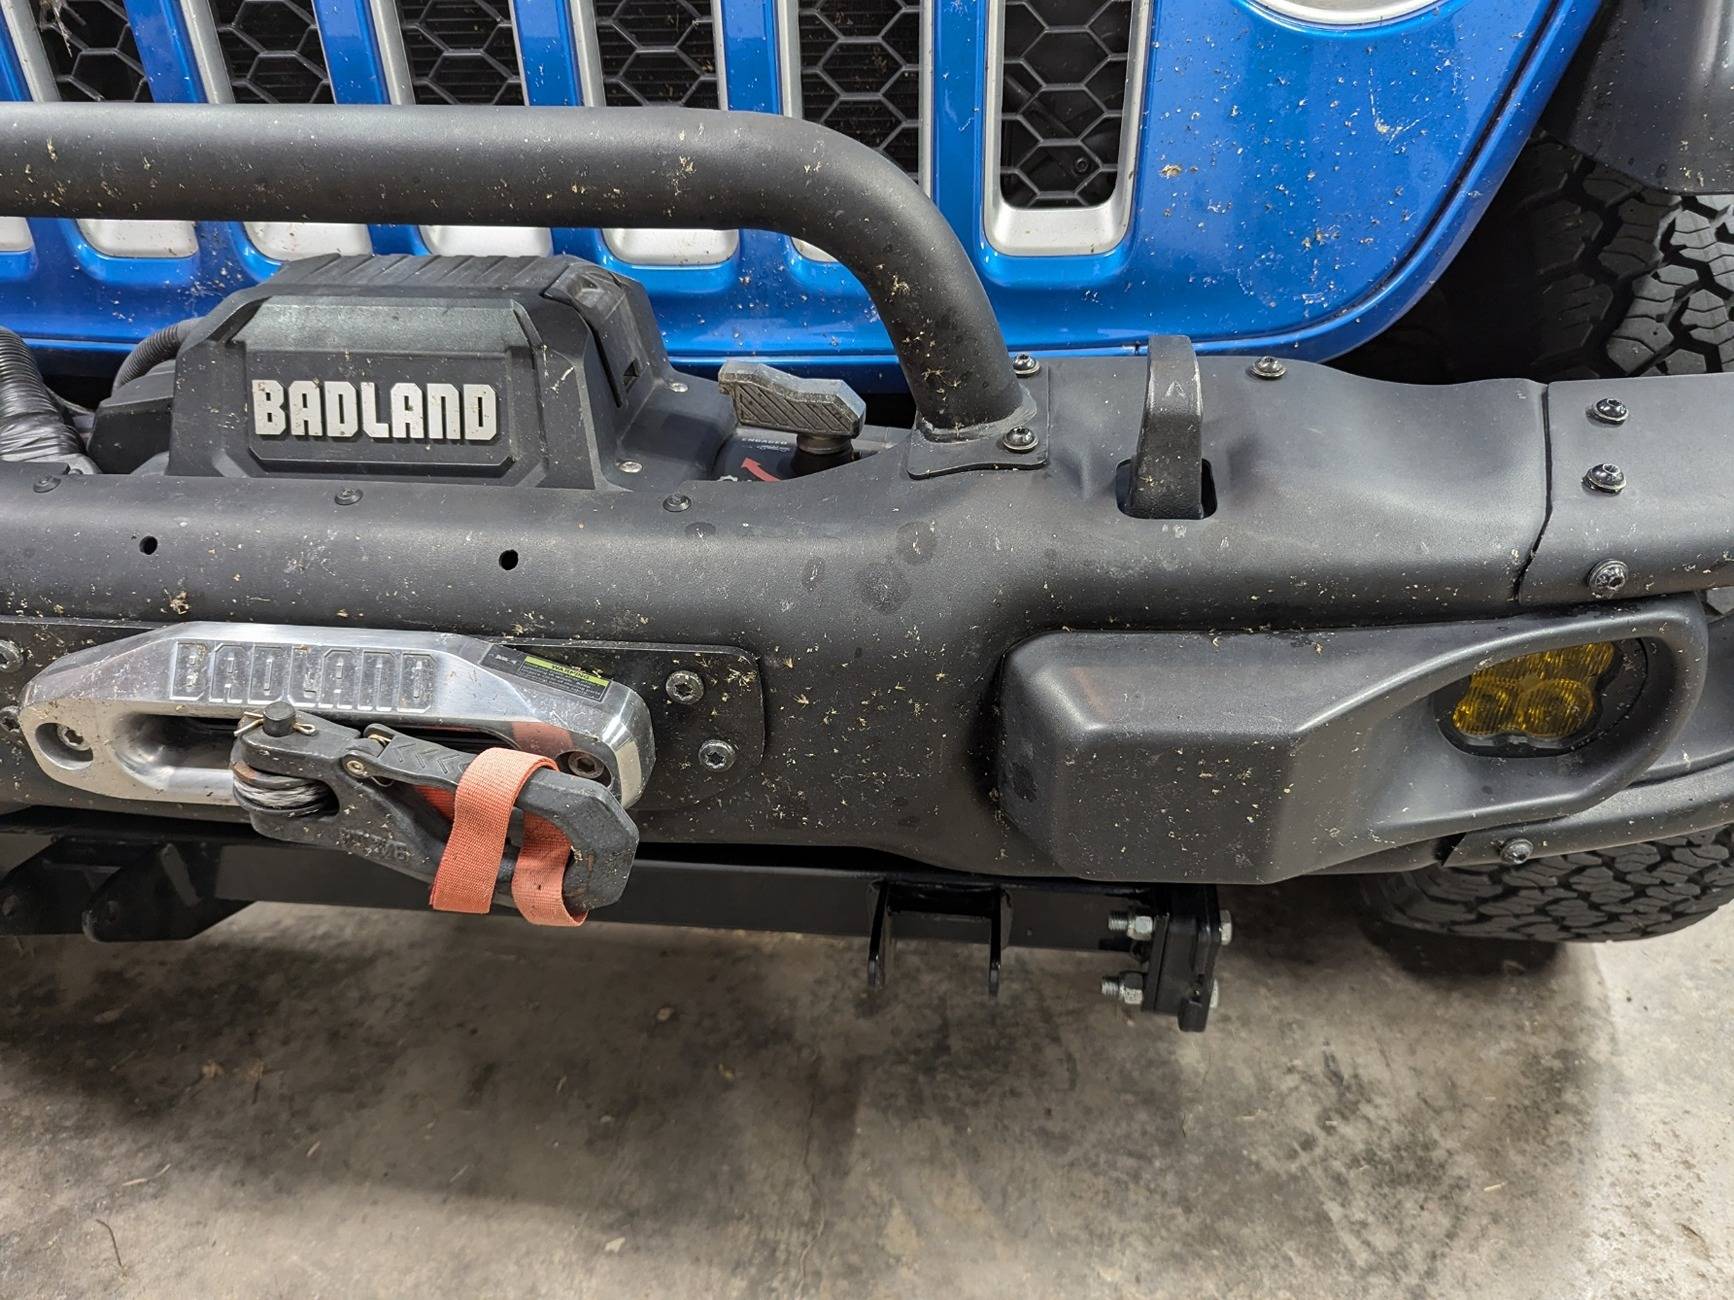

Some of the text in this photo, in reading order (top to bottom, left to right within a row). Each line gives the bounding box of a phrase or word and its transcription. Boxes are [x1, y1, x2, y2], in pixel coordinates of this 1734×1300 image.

[252, 380, 497, 441] BADLAND
[170, 642, 437, 713] BADLAND
[551, 665, 591, 680] WARNING
